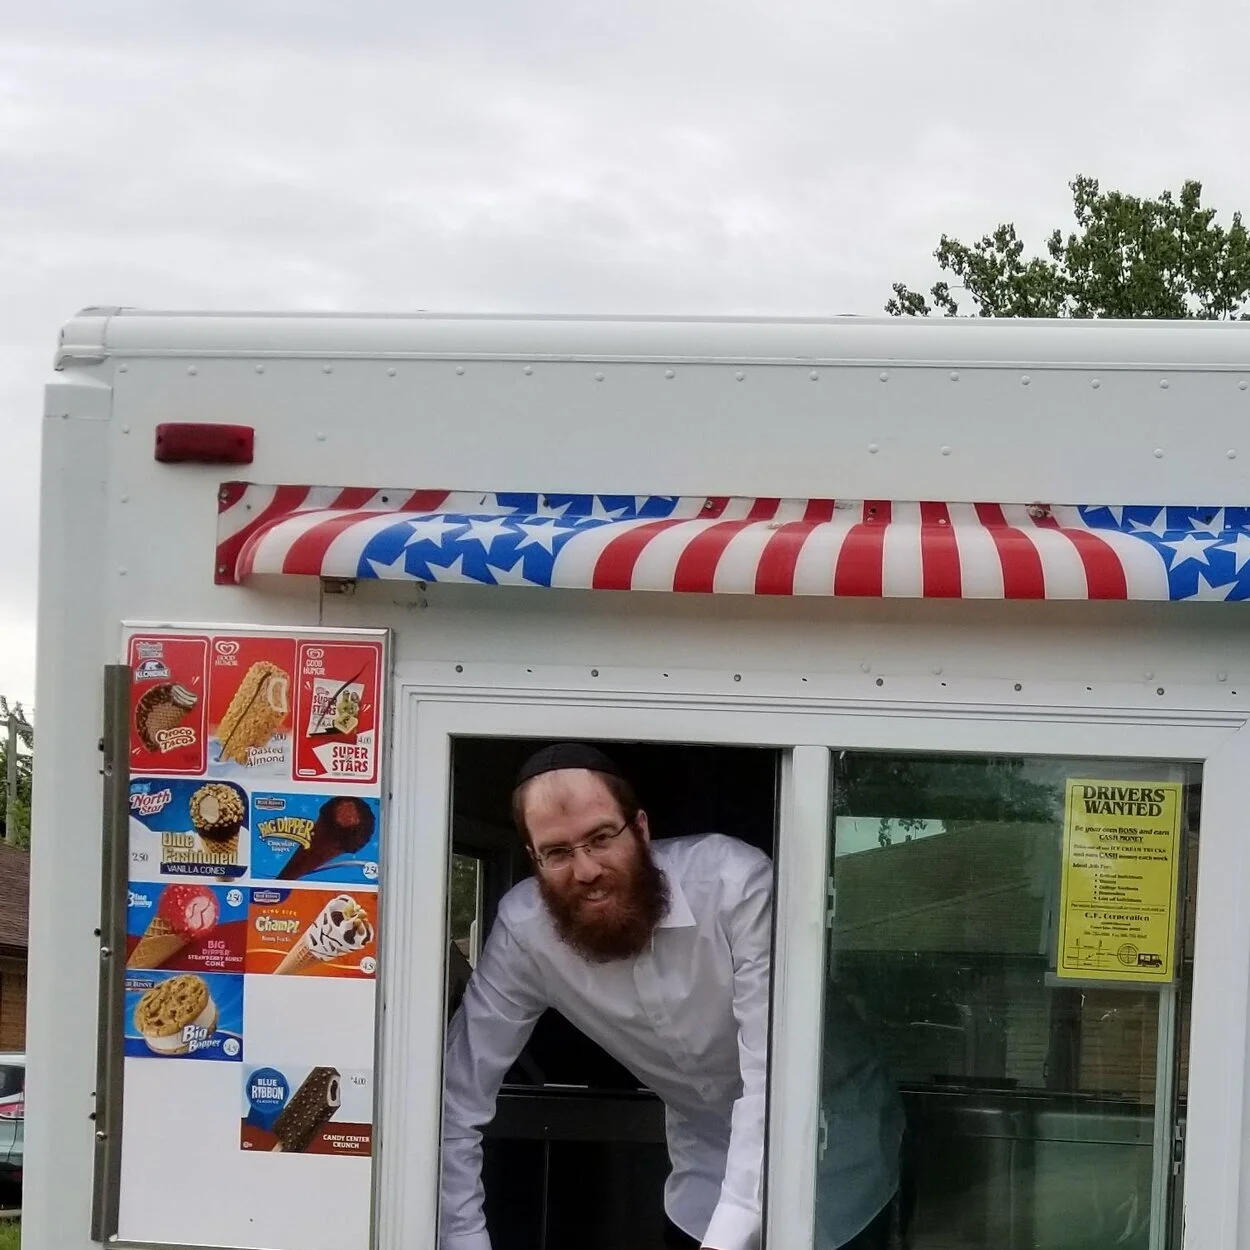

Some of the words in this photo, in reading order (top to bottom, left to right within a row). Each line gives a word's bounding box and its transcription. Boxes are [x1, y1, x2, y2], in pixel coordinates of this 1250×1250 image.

[332, 746, 368, 759] SUPER
[246, 755, 284, 767] Almond
[332, 760, 368, 772] STARS
[131, 790, 170, 806] North
[1083, 786, 1165, 803] DRIVERS
[1085, 801, 1162, 817] WANTED
[167, 865, 199, 873] VANILLA
[200, 865, 226, 875] CONES
[208, 941, 225, 949] BIG
[183, 1025, 207, 1041] Big
[189, 1038, 221, 1052] Bopper
[252, 1086, 284, 1100] RIBBON
